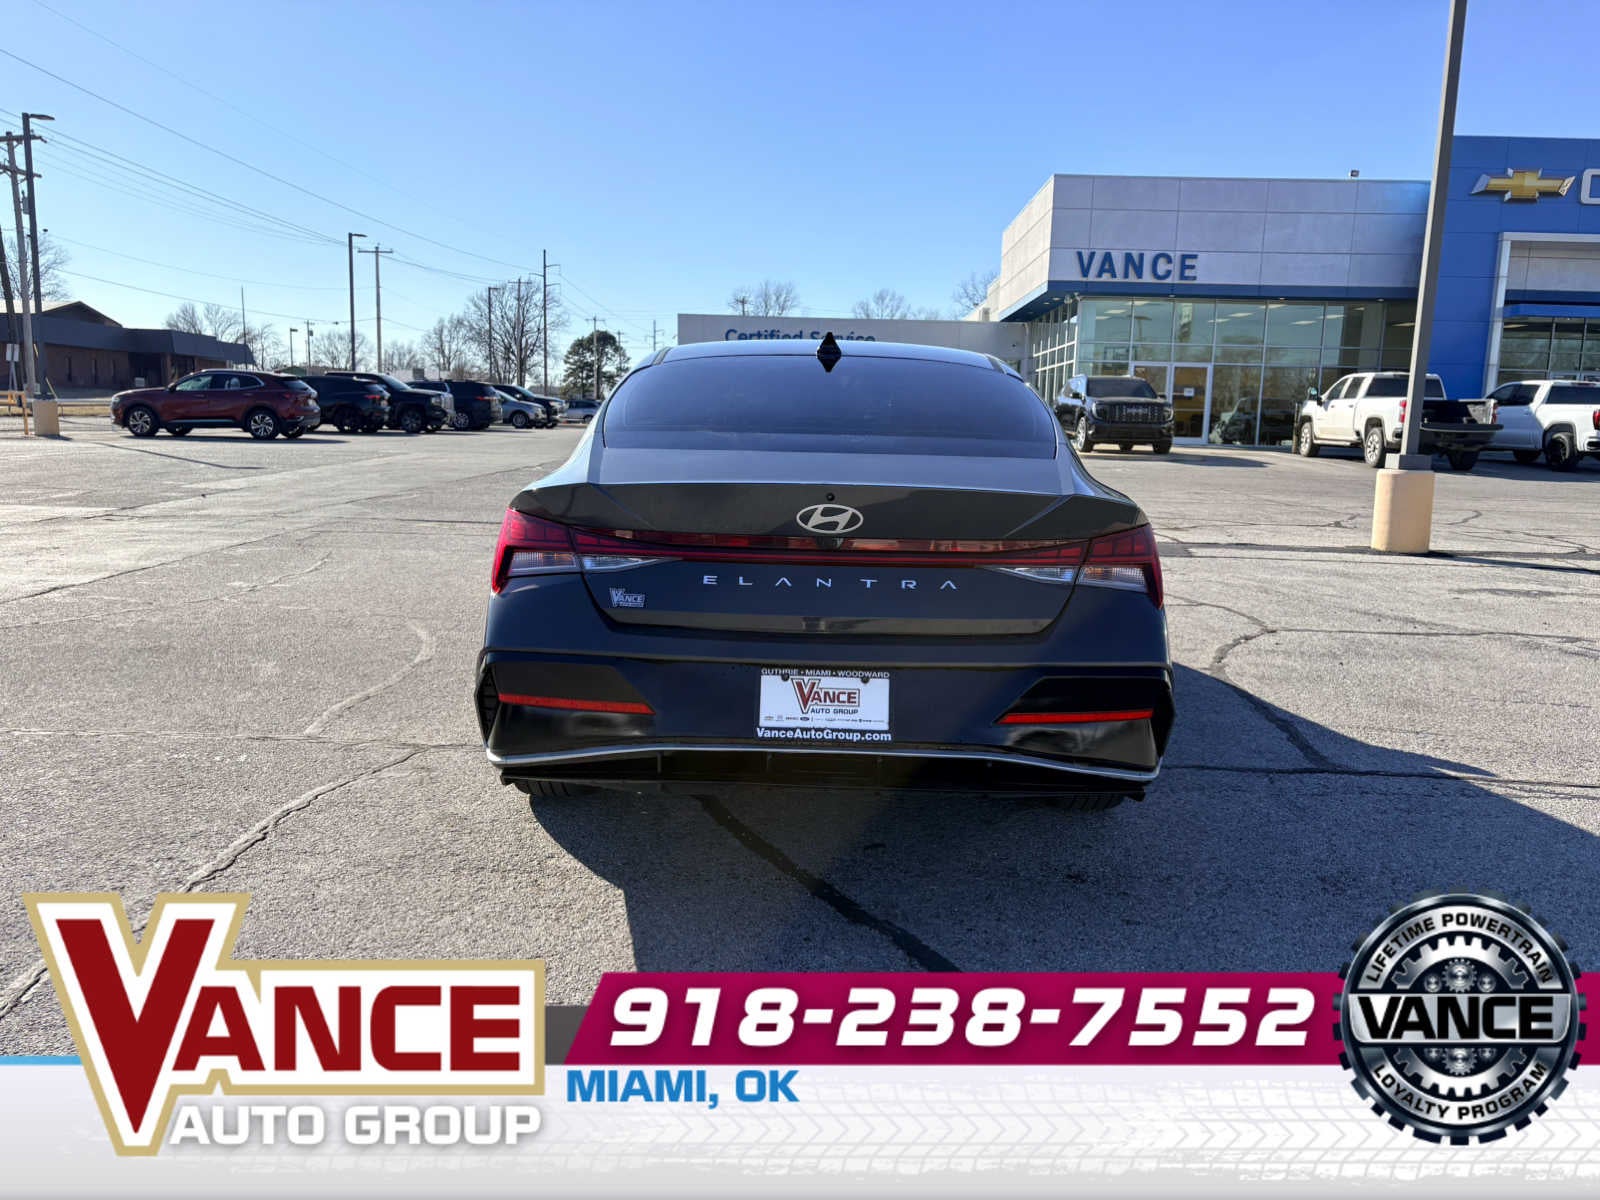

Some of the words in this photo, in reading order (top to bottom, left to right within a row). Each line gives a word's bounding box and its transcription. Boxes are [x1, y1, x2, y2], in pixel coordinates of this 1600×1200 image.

[1076, 251, 1199, 281] VANCE
[703, 575, 957, 590] ELANTRA
[610, 588, 645, 605] VANCE
[805, 669, 831, 677] MIAMI
[837, 670, 890, 679] WOODWARD
[794, 680, 857, 711] VANCE
[756, 727, 892, 741] VanceAutoGroup.com
